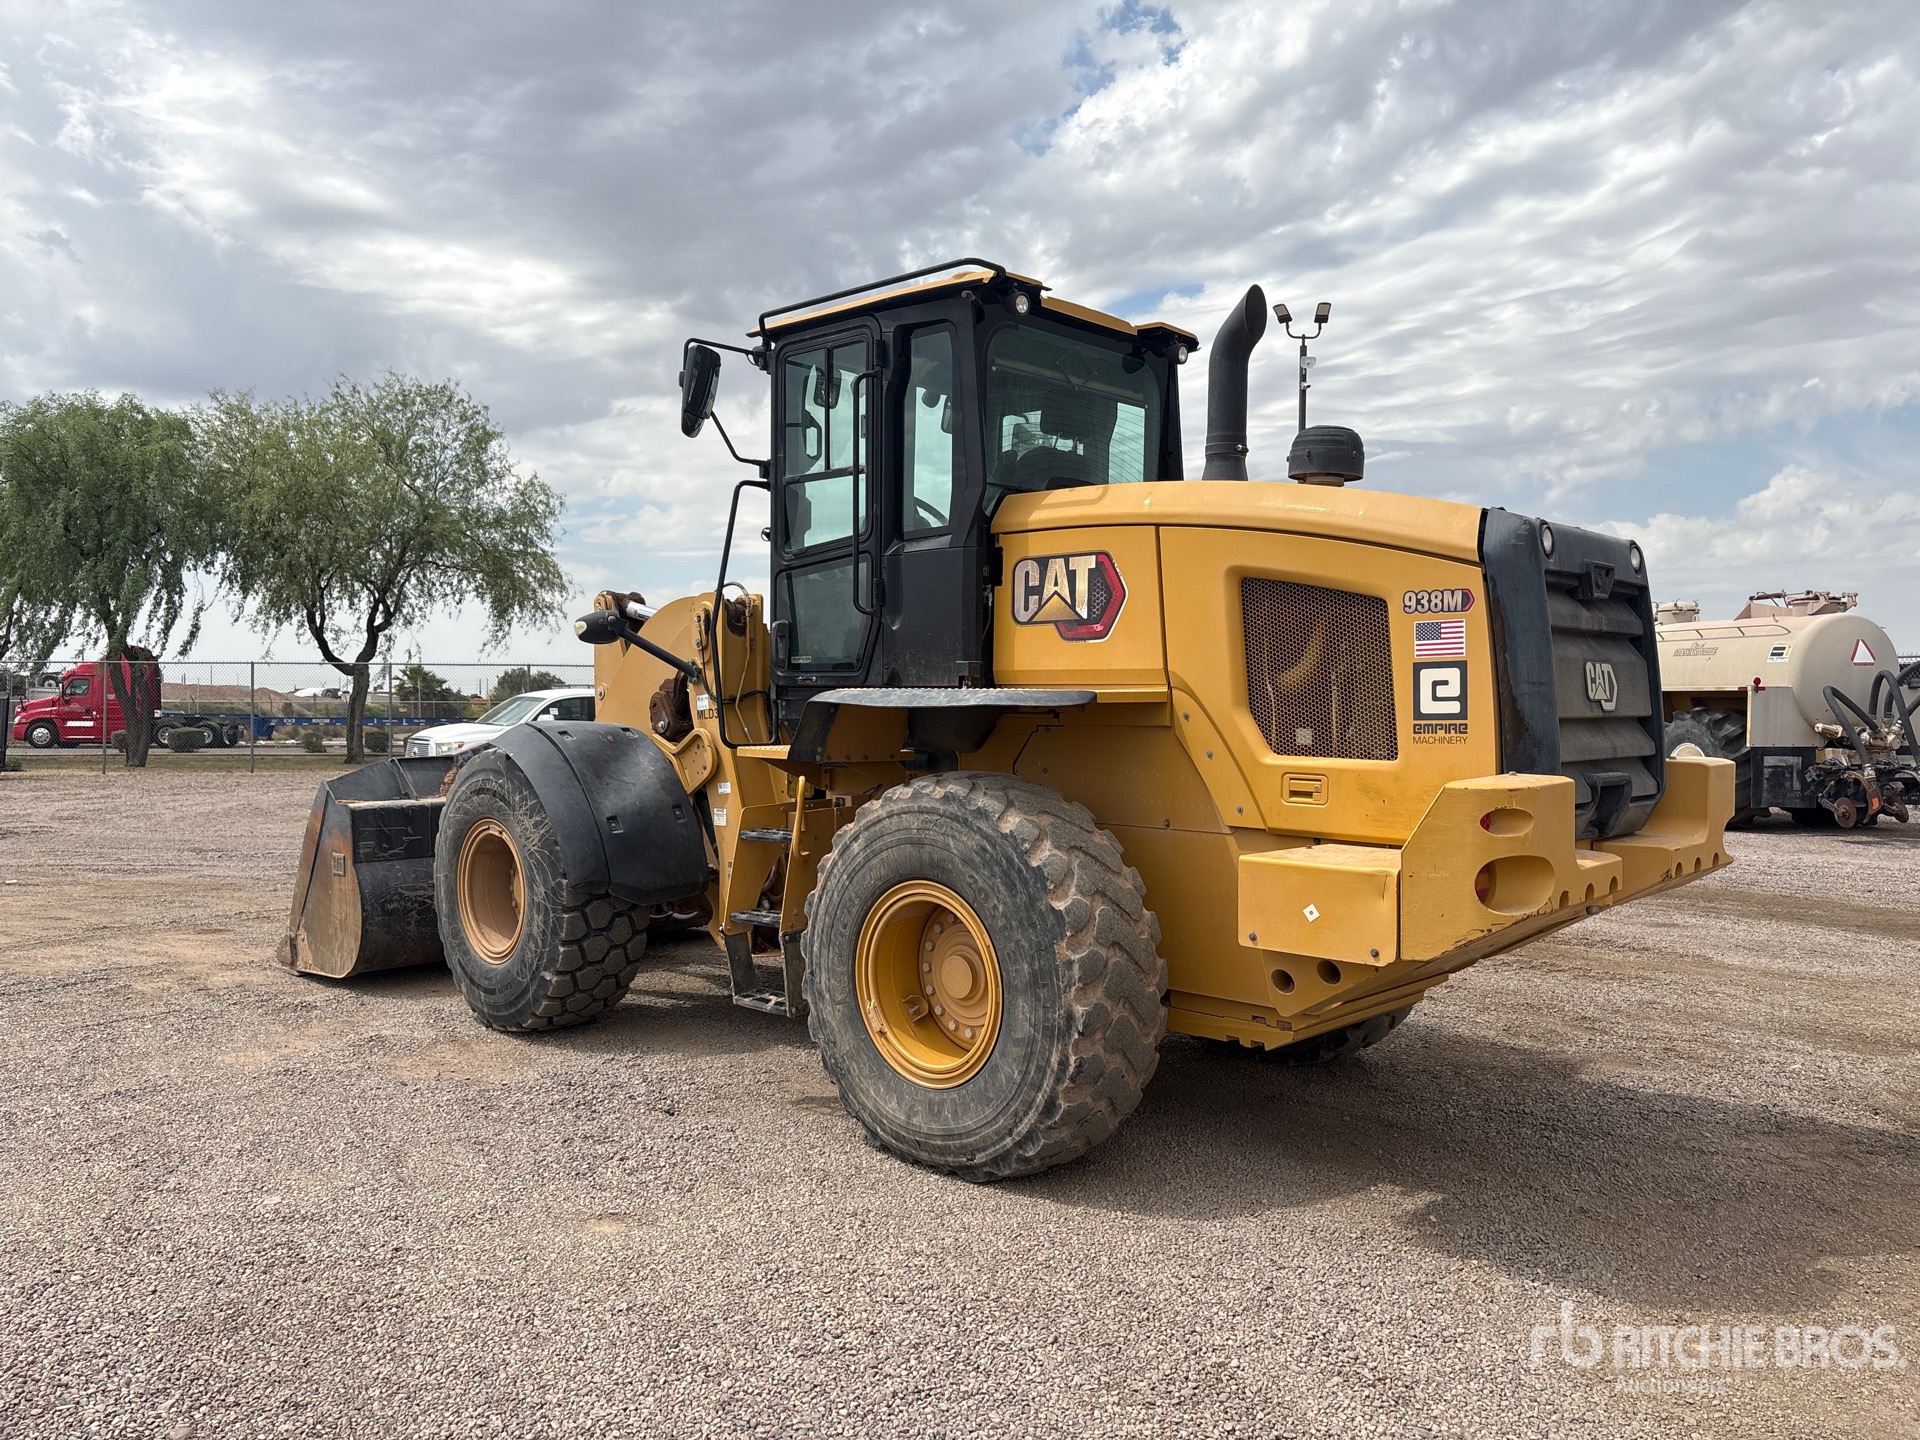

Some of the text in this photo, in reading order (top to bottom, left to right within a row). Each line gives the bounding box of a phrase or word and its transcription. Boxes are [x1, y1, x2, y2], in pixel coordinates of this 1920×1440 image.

[1014, 555, 1096, 623] CAT
[1403, 589, 1463, 613] 938M
[1585, 661, 1612, 700] CAT
[1412, 735, 1469, 745] MACHINERY
